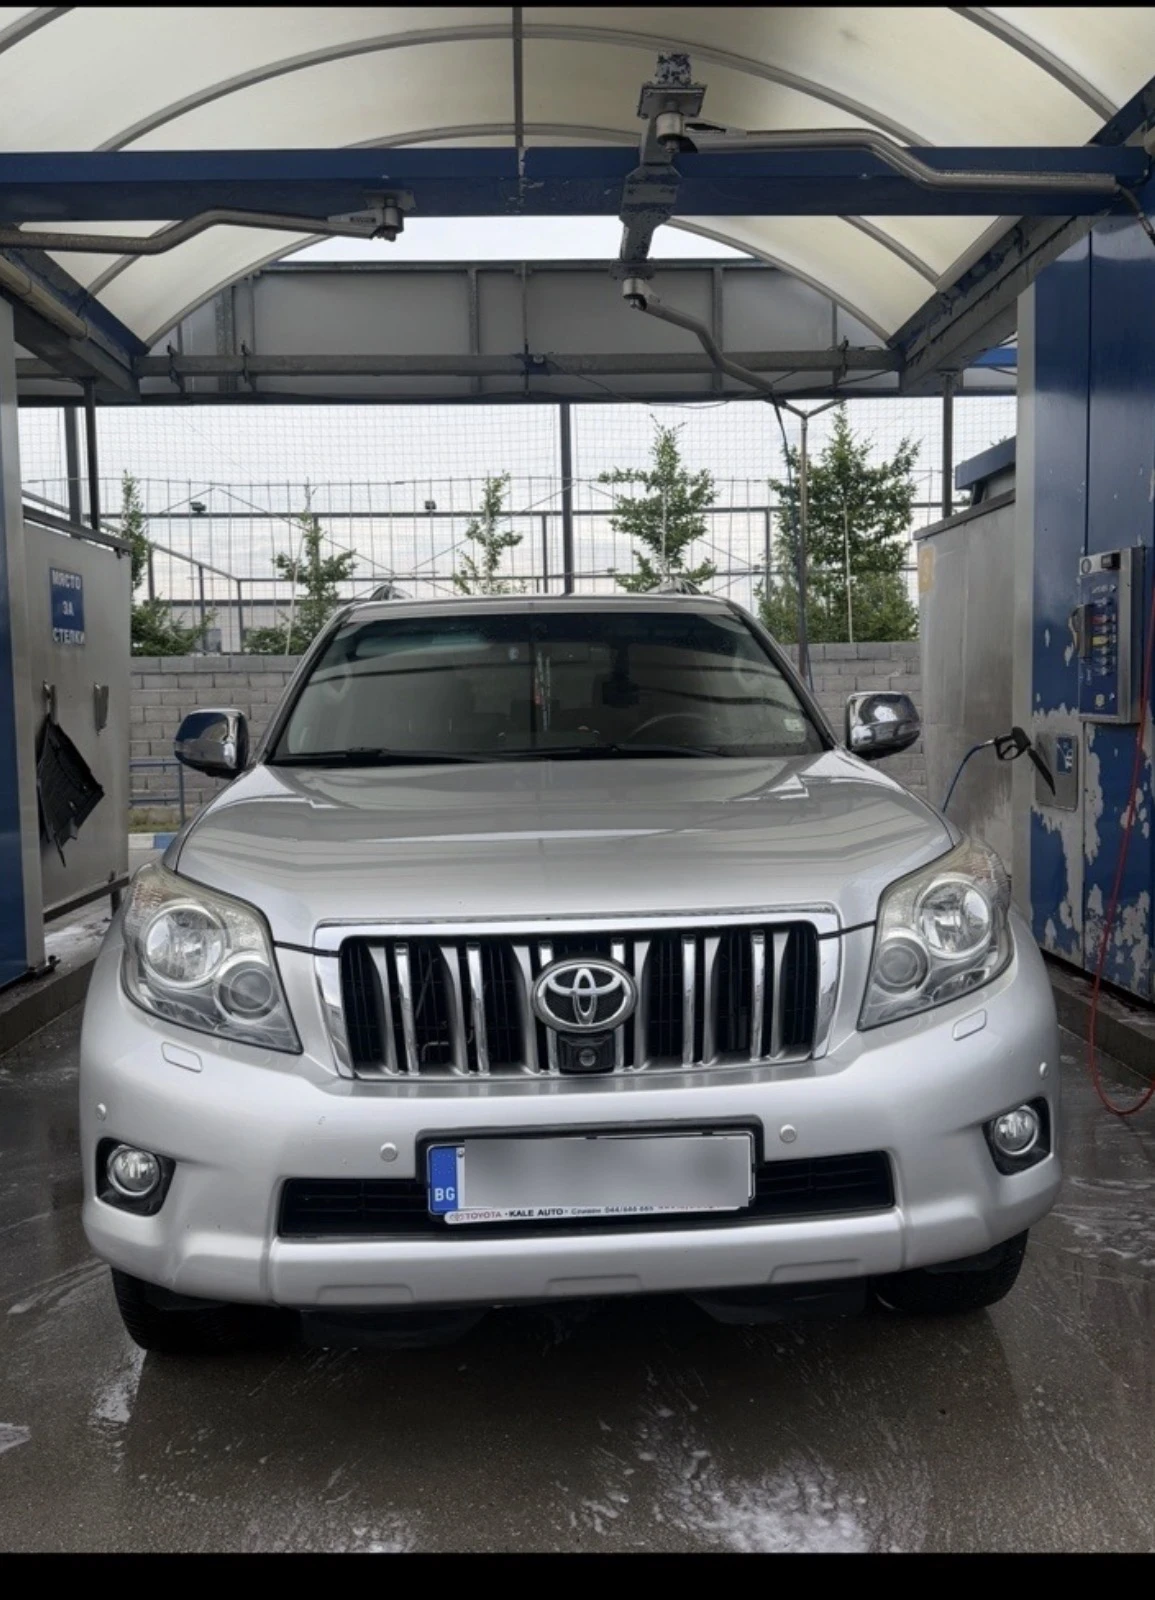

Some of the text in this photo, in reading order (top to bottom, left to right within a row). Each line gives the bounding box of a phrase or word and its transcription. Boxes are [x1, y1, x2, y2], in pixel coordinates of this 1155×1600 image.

[52, 570, 82, 590] МЯСТО
[62, 600, 75, 616] ЗА
[53, 627, 85, 645] СТЕЛКИ
[434, 1187, 456, 1202] BG
[466, 1211, 502, 1221] TOYOTA
[508, 1208, 534, 1217] KALE
[538, 1207, 564, 1217] AUTO
